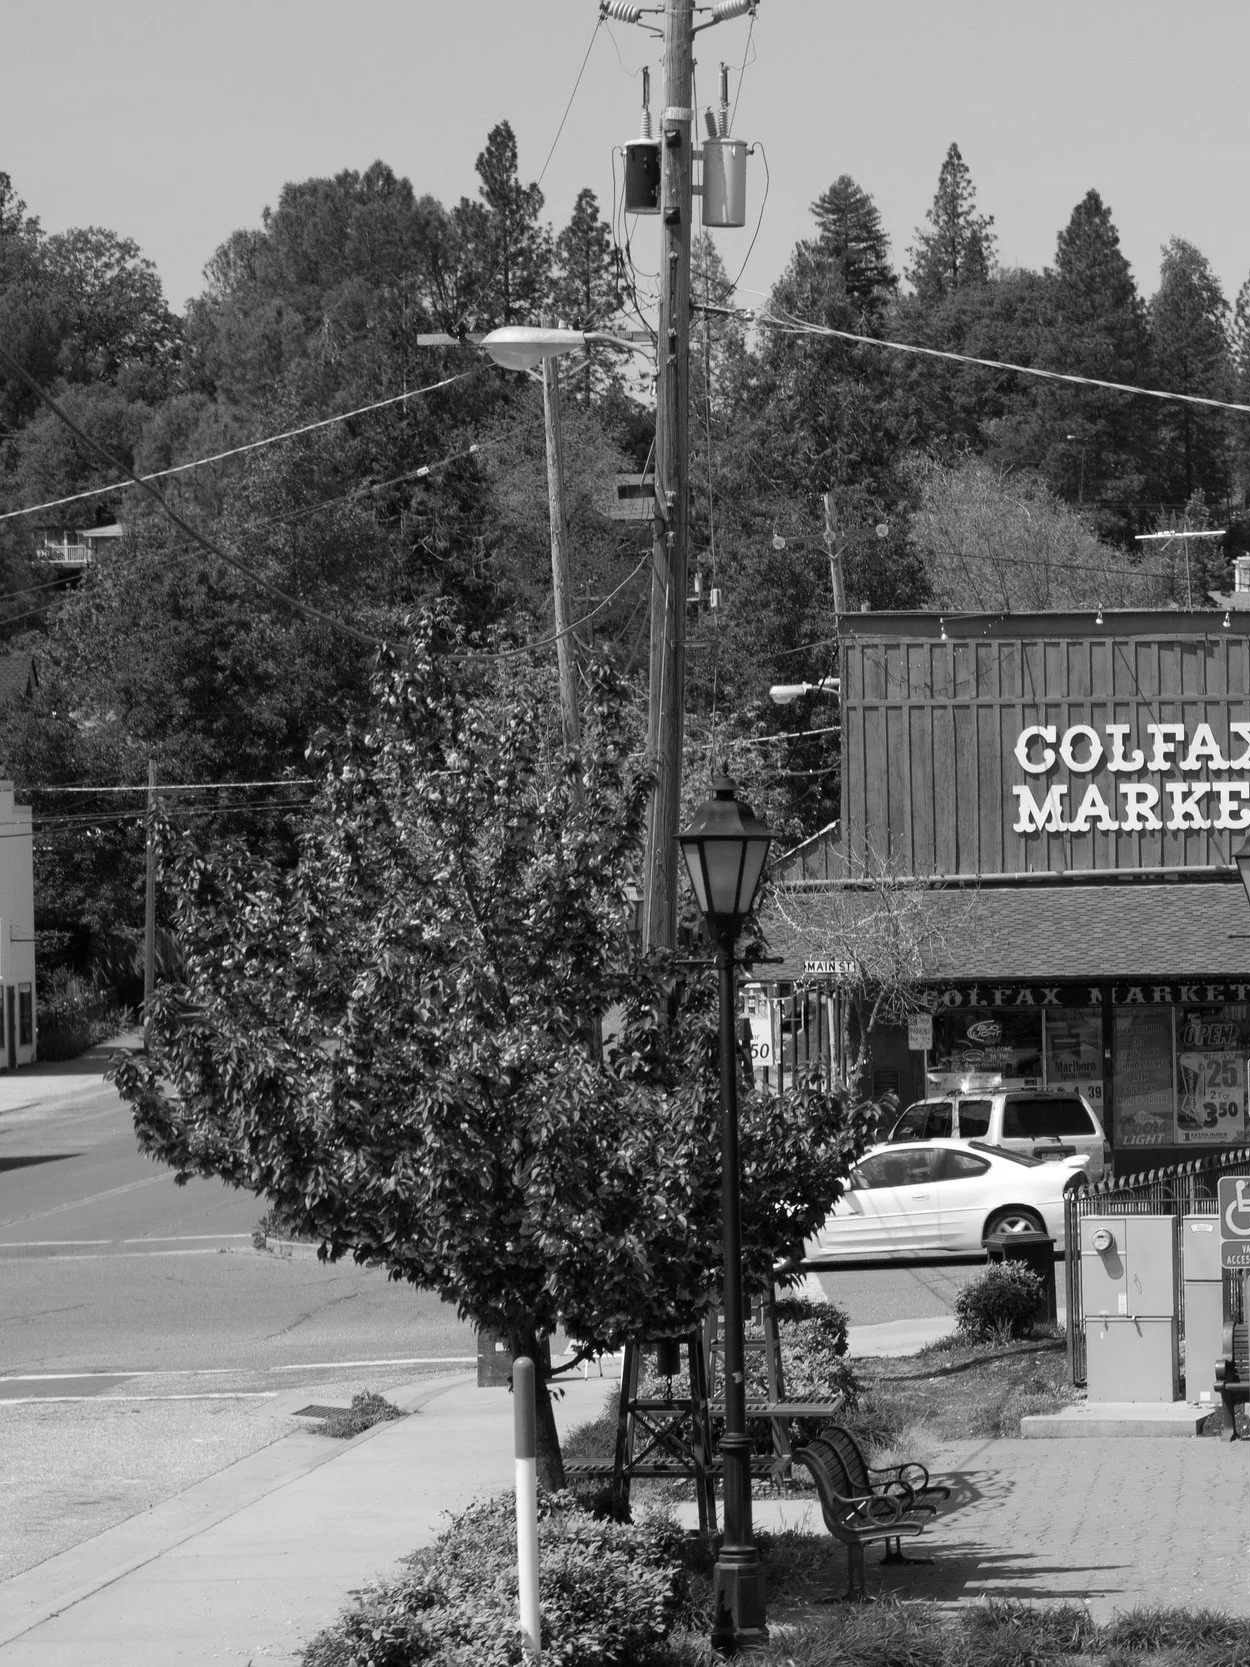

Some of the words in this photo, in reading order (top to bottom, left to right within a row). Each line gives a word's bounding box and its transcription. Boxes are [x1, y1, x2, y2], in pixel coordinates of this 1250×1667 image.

[807, 962, 836, 972] MAIN
[838, 961, 852, 972] ST
[923, 988, 1062, 1008] COLFAX
[1183, 1023, 1233, 1046] OPEN
[1055, 1060, 1096, 1072] Marlboro
[1207, 1059, 1238, 1088] 25
[1088, 1086, 1102, 1099] 39
[1122, 1133, 1166, 1145] LIGHT
